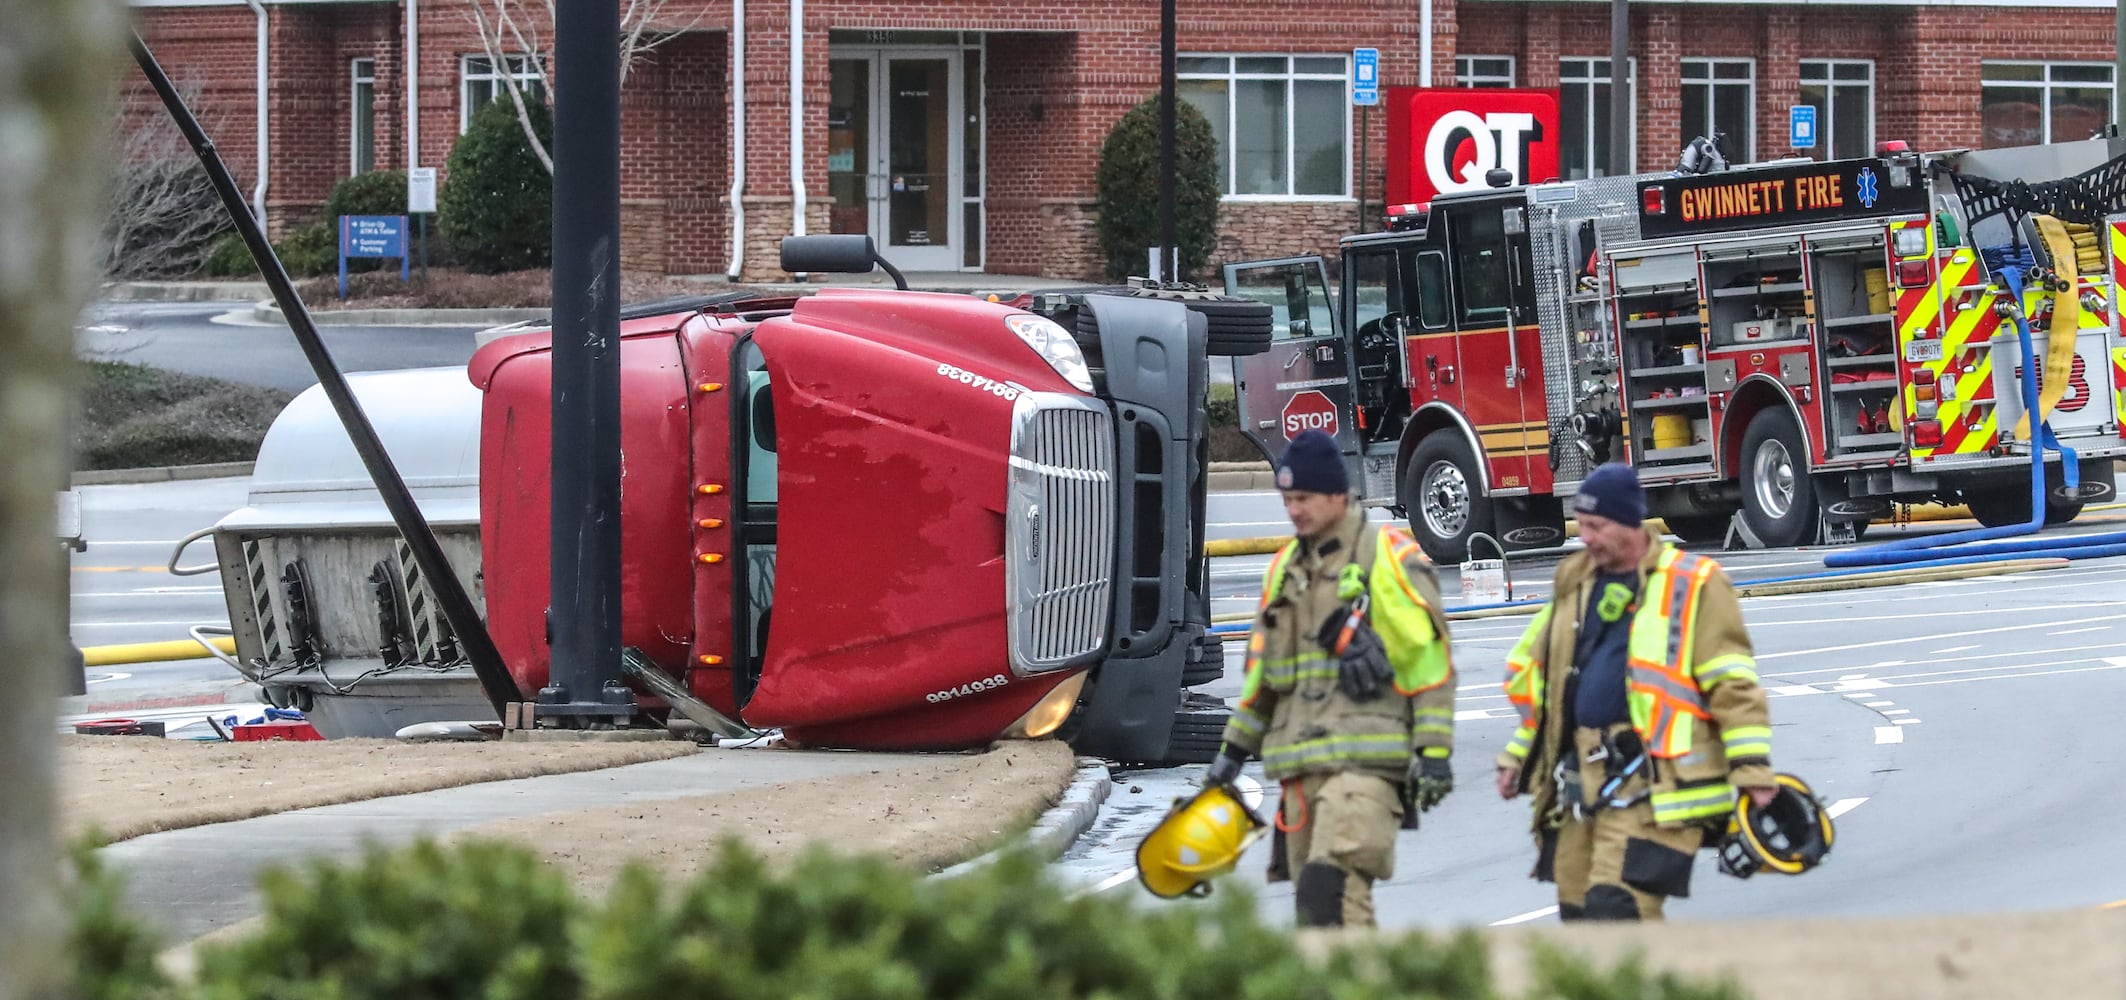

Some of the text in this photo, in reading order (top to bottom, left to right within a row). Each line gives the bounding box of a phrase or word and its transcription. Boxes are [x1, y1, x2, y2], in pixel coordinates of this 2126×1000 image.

[867, 31, 894, 42] 3350
[1425, 110, 1534, 194] QT
[1680, 174, 1843, 222] GWINNETT FIRE
[936, 363, 1019, 401] 9914938
[1286, 411, 1334, 432] STOP
[926, 674, 1009, 703] 9914938
